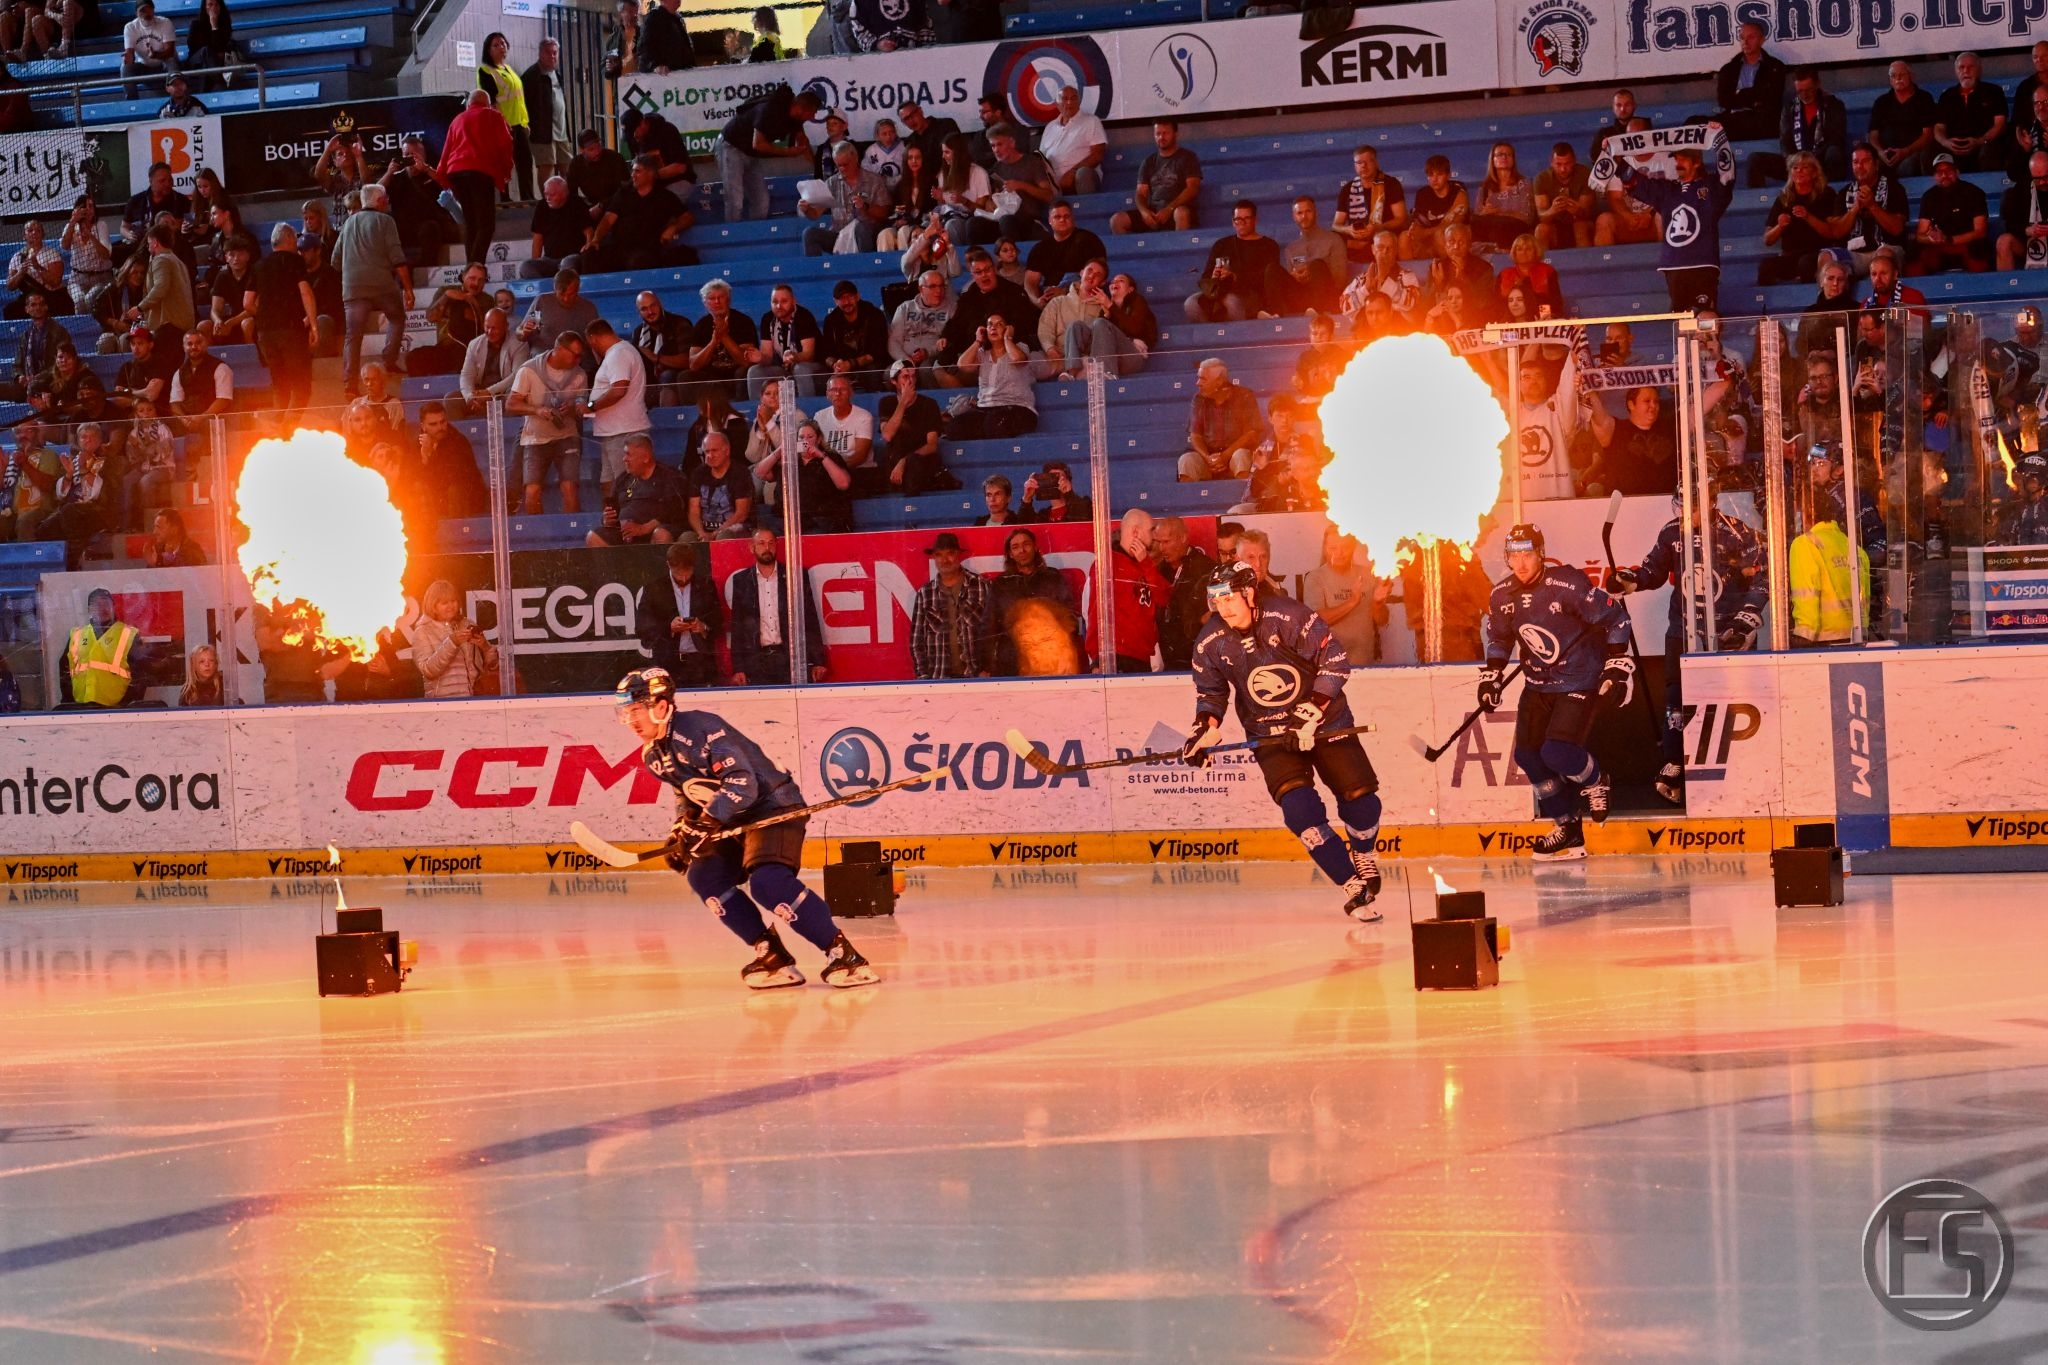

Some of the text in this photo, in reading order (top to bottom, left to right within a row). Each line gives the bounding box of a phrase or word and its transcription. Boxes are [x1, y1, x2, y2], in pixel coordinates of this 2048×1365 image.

[1301, 38, 1447, 87] KERMI
[844, 78, 968, 111] ŠKODA JS
[1620, 134, 1646, 151] HC
[1606, 366, 1657, 387] ŠKODA
[2004, 584, 2048, 597] Tipspo
[1847, 682, 1872, 798] CCM
[904, 731, 1091, 791] ŠKODA
[344, 746, 665, 814] CCM
[1128, 770, 1246, 784] stavební firma
[0, 763, 220, 814] nterCora
[1153, 786, 1228, 795] www.d-beton.cz
[1668, 828, 1746, 849] Tipsport
[1988, 817, 2048, 840] Tipspo
[881, 845, 926, 863] sport
[1008, 841, 1078, 862] Tipsport
[1168, 839, 1239, 860] Tipsport
[21, 862, 78, 881] Tipsport
[149, 860, 208, 879] Tipsport
[420, 854, 482, 874] Tipsport
